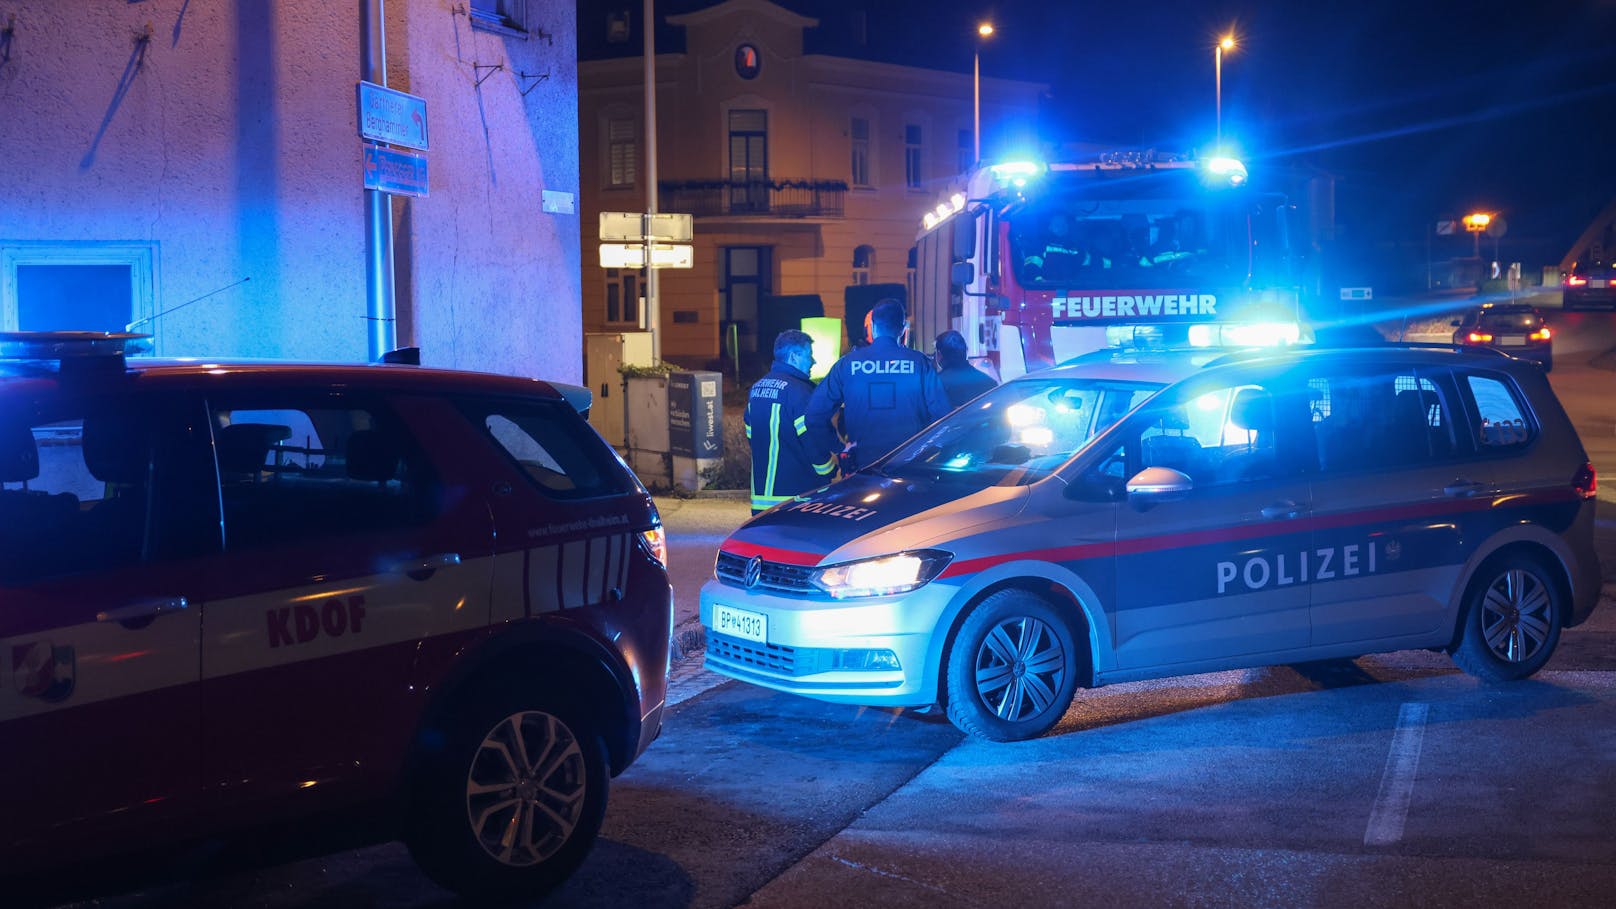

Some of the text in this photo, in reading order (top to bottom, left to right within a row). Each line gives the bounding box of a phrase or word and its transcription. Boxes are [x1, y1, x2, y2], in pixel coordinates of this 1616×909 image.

[366, 111, 409, 137] Berghammer
[1051, 294, 1217, 318] FEUERWEHR
[851, 360, 915, 375] POLIZEI
[706, 400, 714, 437] liwest.at
[789, 502, 877, 521] POLIZEI
[1217, 542, 1376, 593] POLIZEI
[266, 595, 365, 648] KDOF
[721, 611, 761, 637] BP 41313
